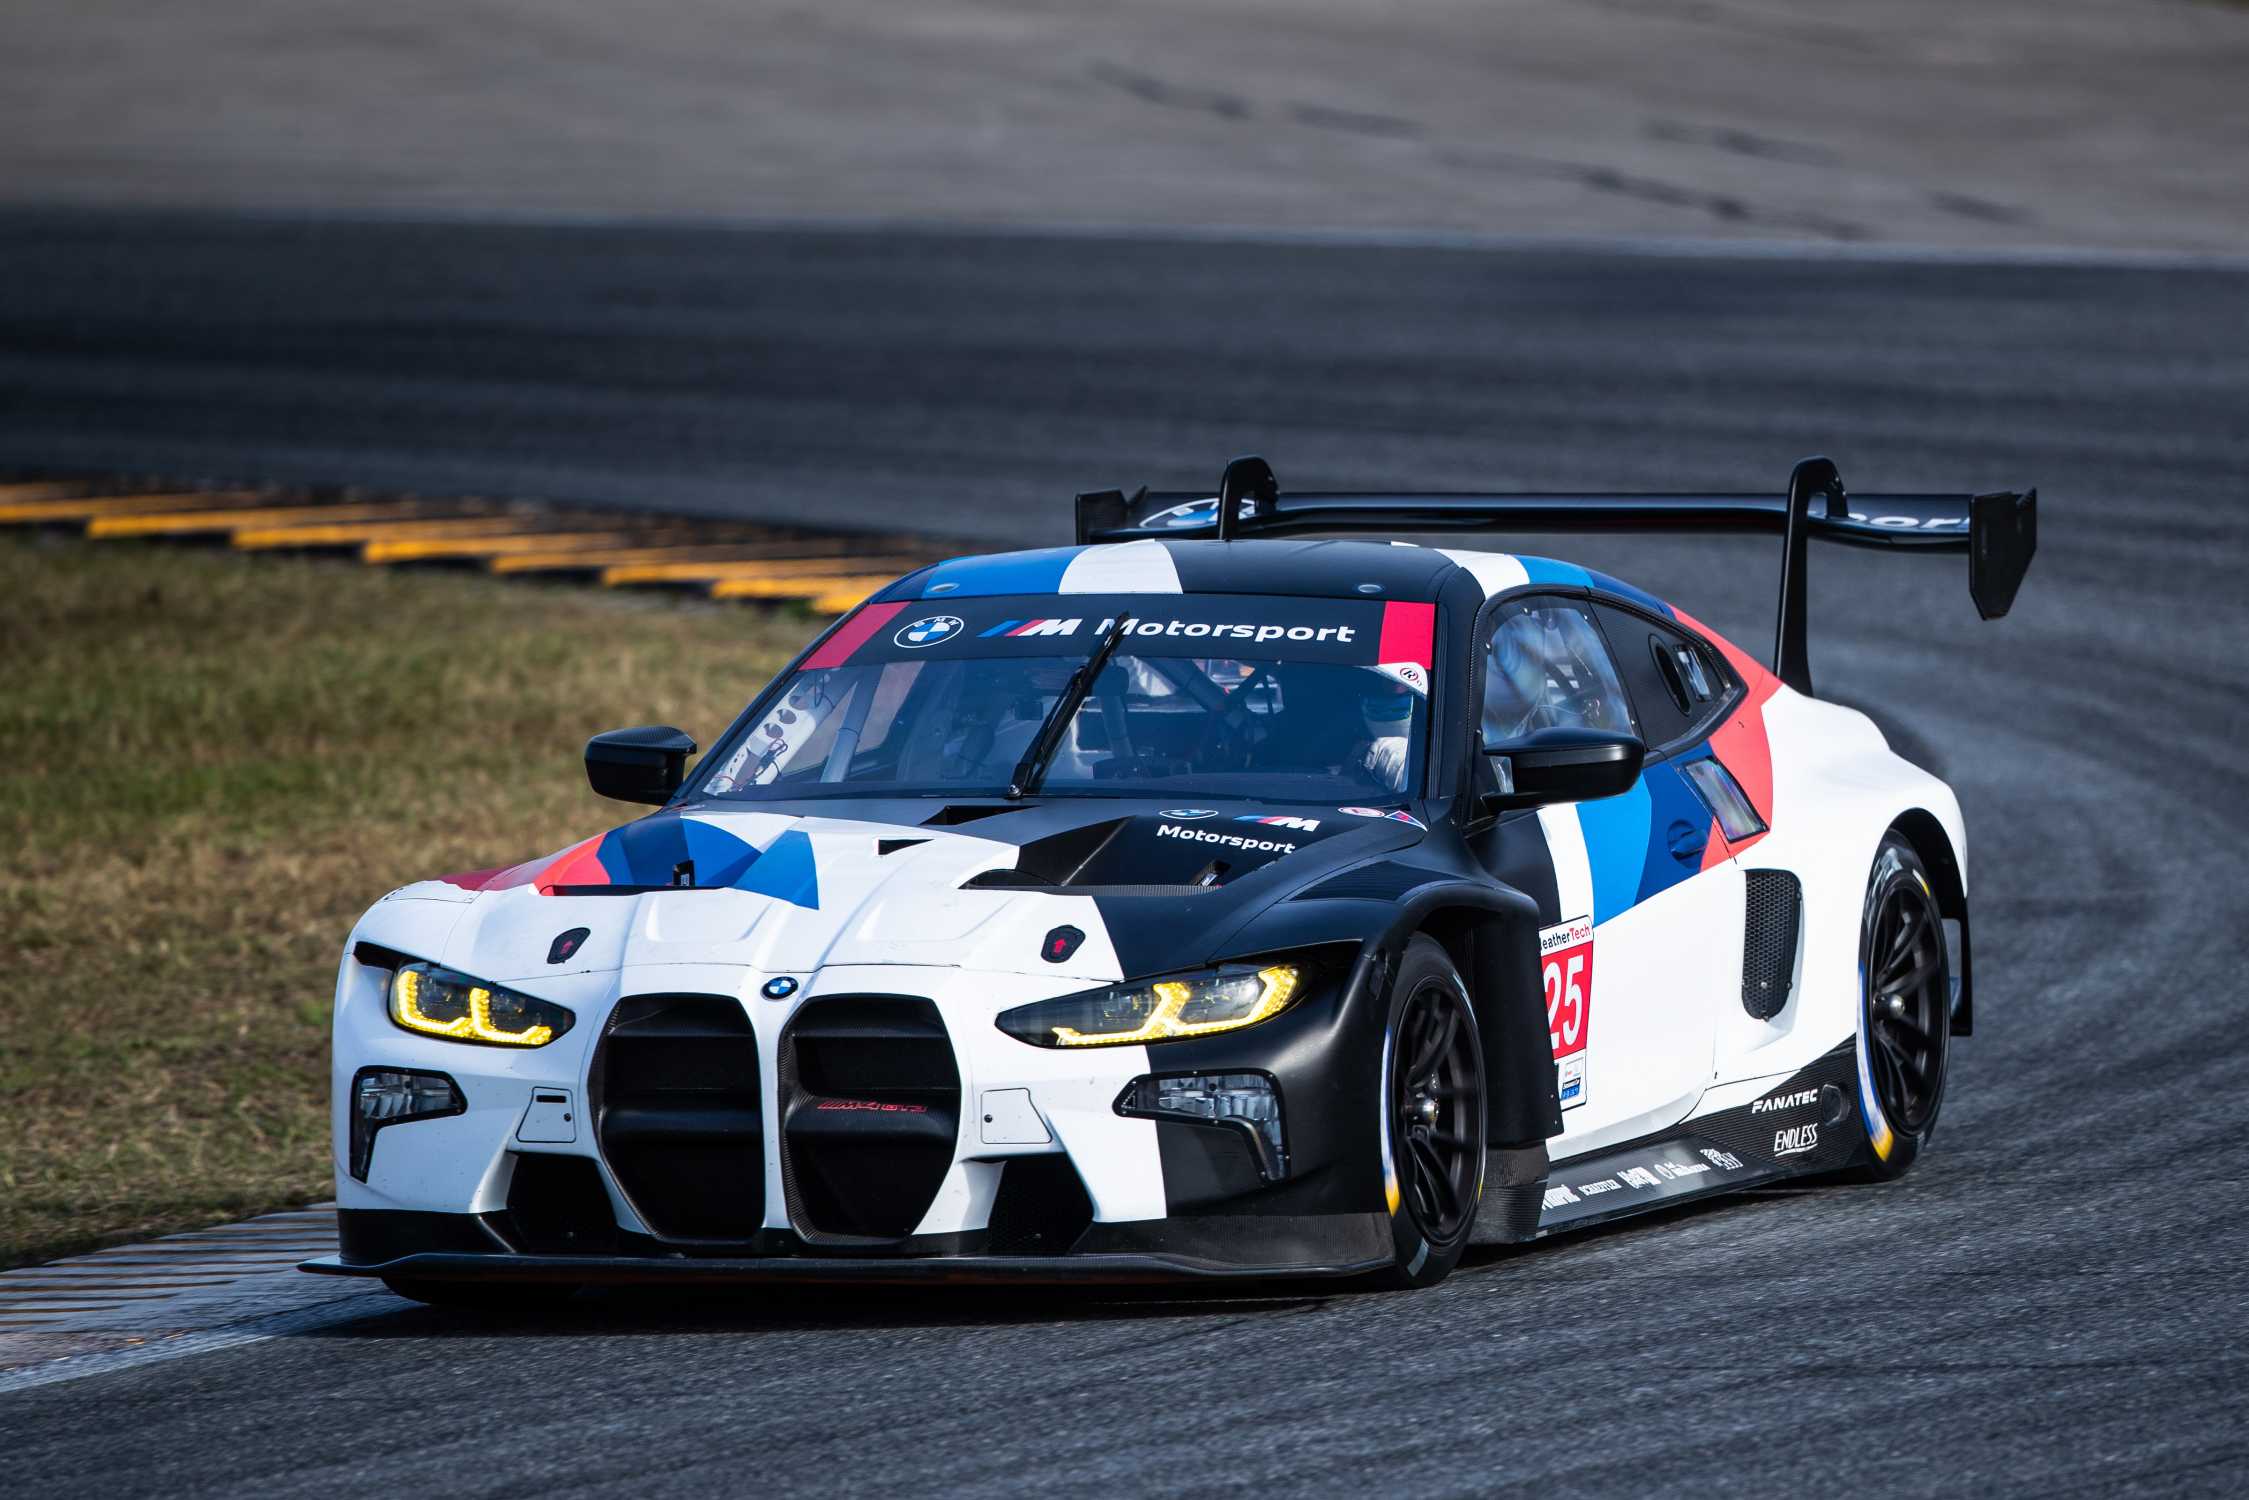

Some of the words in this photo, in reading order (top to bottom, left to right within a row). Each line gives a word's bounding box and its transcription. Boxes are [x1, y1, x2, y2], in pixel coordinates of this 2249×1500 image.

[1094, 617, 1356, 643] Motorsport
[1156, 824, 1296, 854] Motorsport
[1542, 923, 1591, 950] eatherTech
[1543, 954, 1584, 1050] 25
[1751, 1088, 1818, 1114] FANATEC
[1773, 1122, 1818, 1152] ENDLESS
